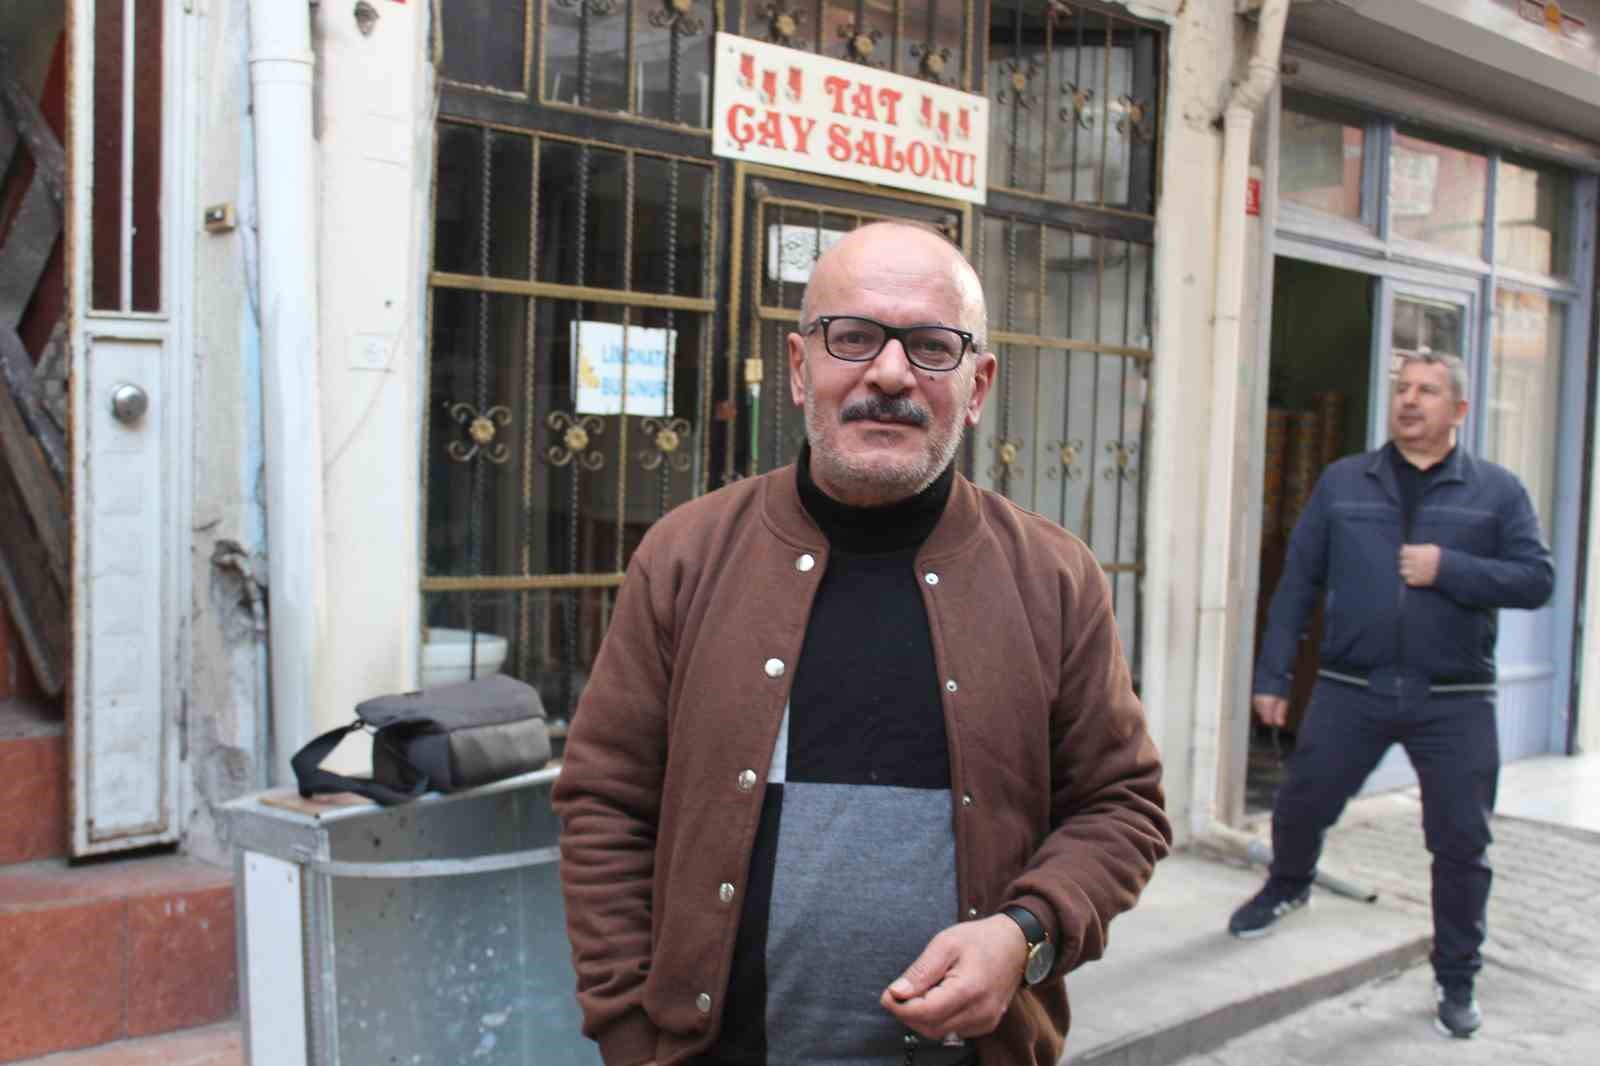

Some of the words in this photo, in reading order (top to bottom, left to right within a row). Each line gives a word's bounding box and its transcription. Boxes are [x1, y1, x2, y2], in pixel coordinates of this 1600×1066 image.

[825, 76, 902, 125] TAT
[727, 103, 816, 153] ÇAY
[827, 123, 976, 188] SALONU
